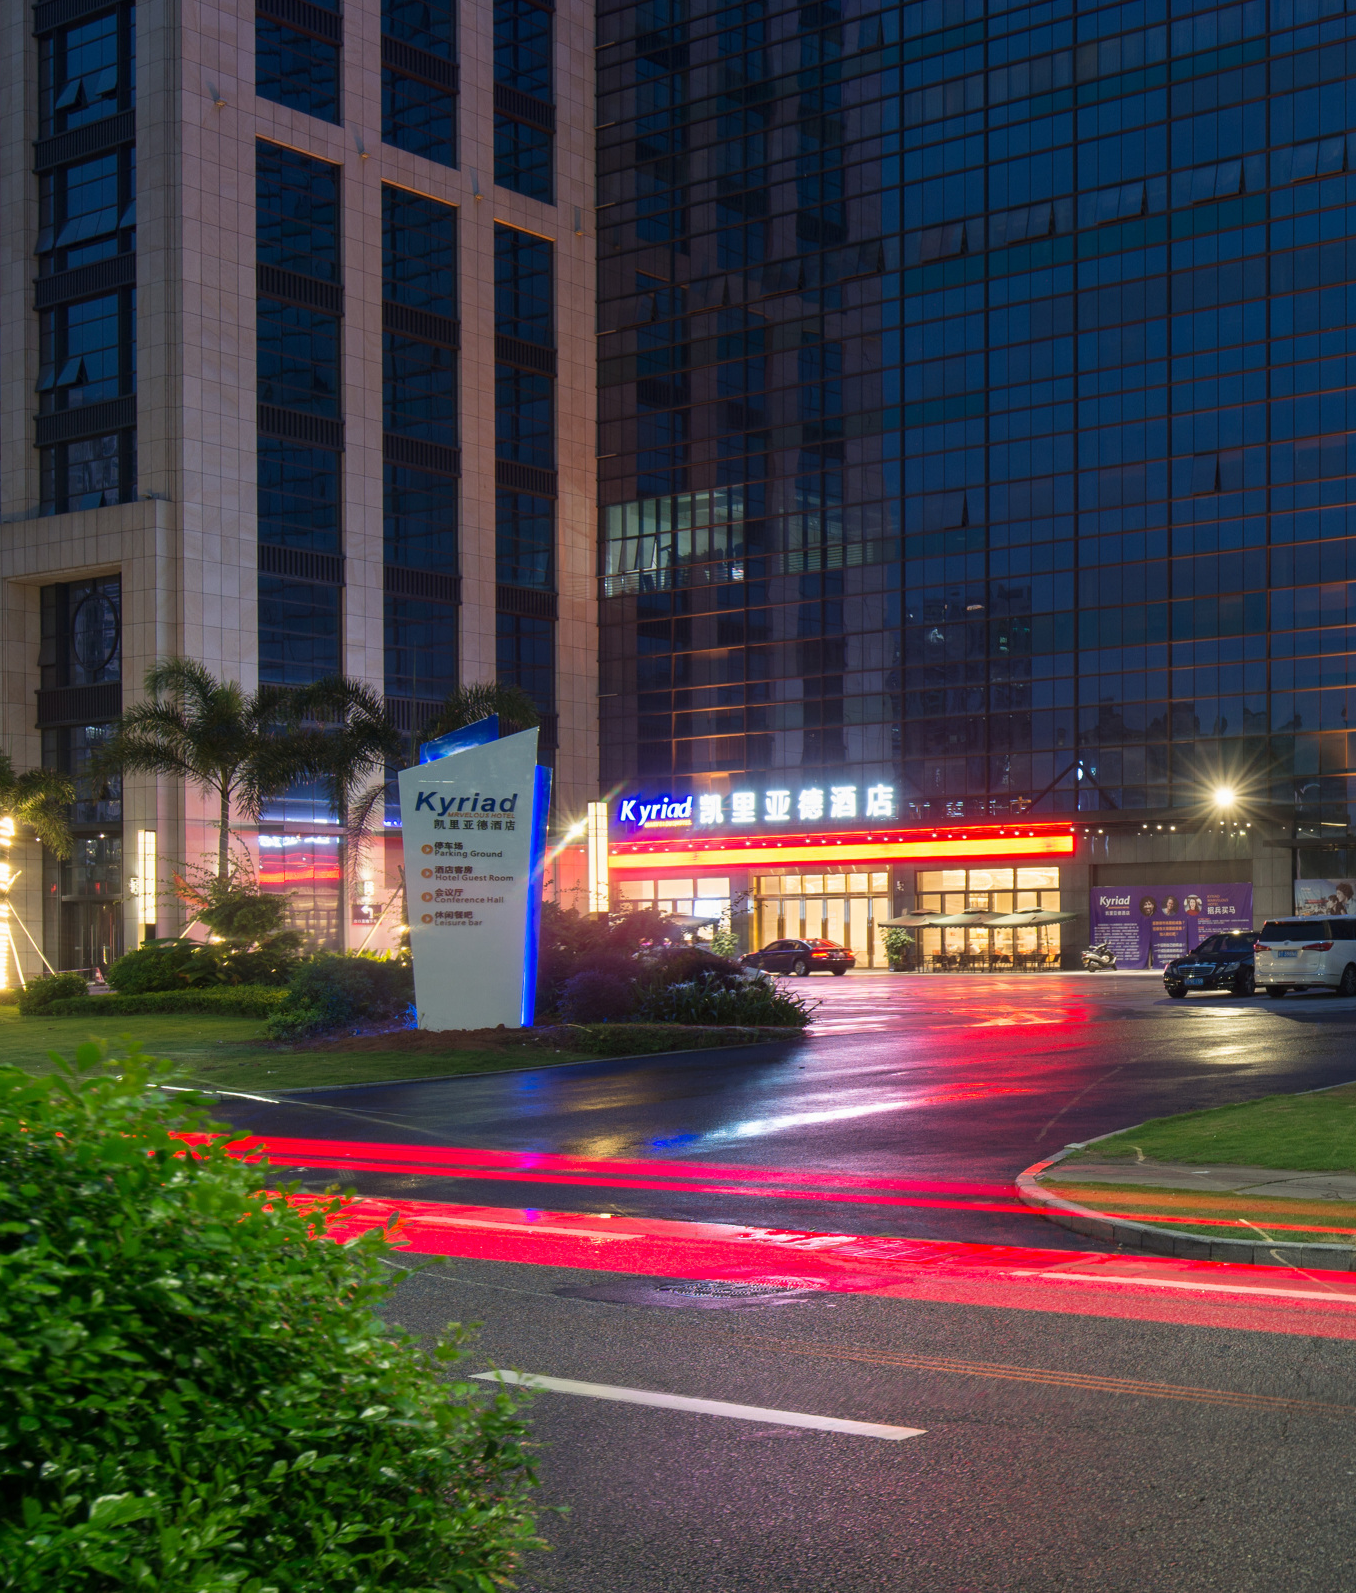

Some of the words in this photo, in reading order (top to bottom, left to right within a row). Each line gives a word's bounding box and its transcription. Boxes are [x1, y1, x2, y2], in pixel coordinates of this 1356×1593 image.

[415, 791, 518, 816] Kyriad
[620, 795, 693, 826] Kyriad
[699, 784, 894, 825] 凯里亚德酒店
[434, 819, 516, 831] 凯里亚德酒店
[434, 842, 464, 850] 停车场
[435, 850, 468, 858] Parking
[470, 850, 503, 858] Ground
[434, 866, 473, 874] 酒店客房
[435, 889, 464, 897] 会议厅
[1100, 895, 1131, 907] Kyriad
[1207, 906, 1236, 914] 招兵买马
[434, 911, 473, 919] 休闲餐吧
